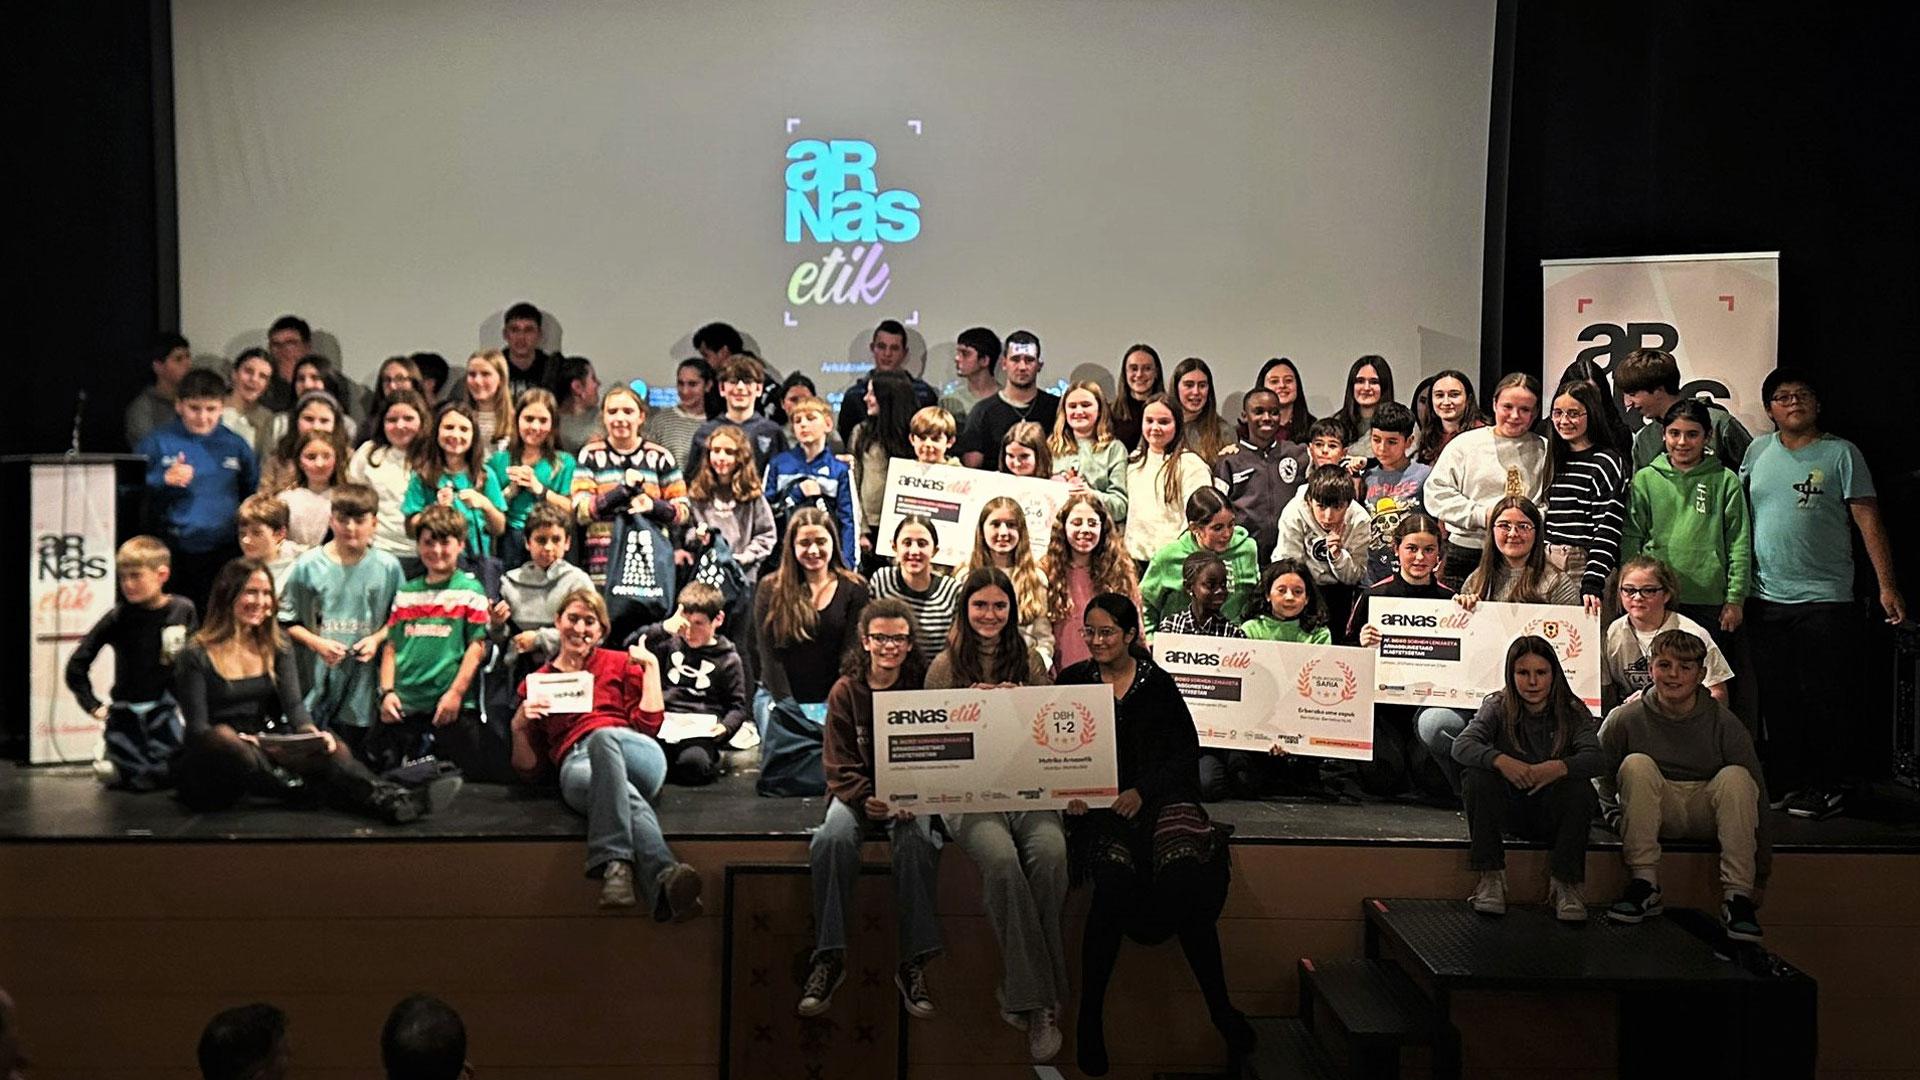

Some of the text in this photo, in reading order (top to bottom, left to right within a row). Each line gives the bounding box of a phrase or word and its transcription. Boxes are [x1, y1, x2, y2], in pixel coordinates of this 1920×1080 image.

[787, 243, 890, 304] etik
[1439, 612, 1470, 629] etik
[1221, 651, 1251, 668] etik
[950, 703, 981, 722] etik
[1053, 711, 1074, 720] DBH
[1054, 721, 1075, 734] 1-2
